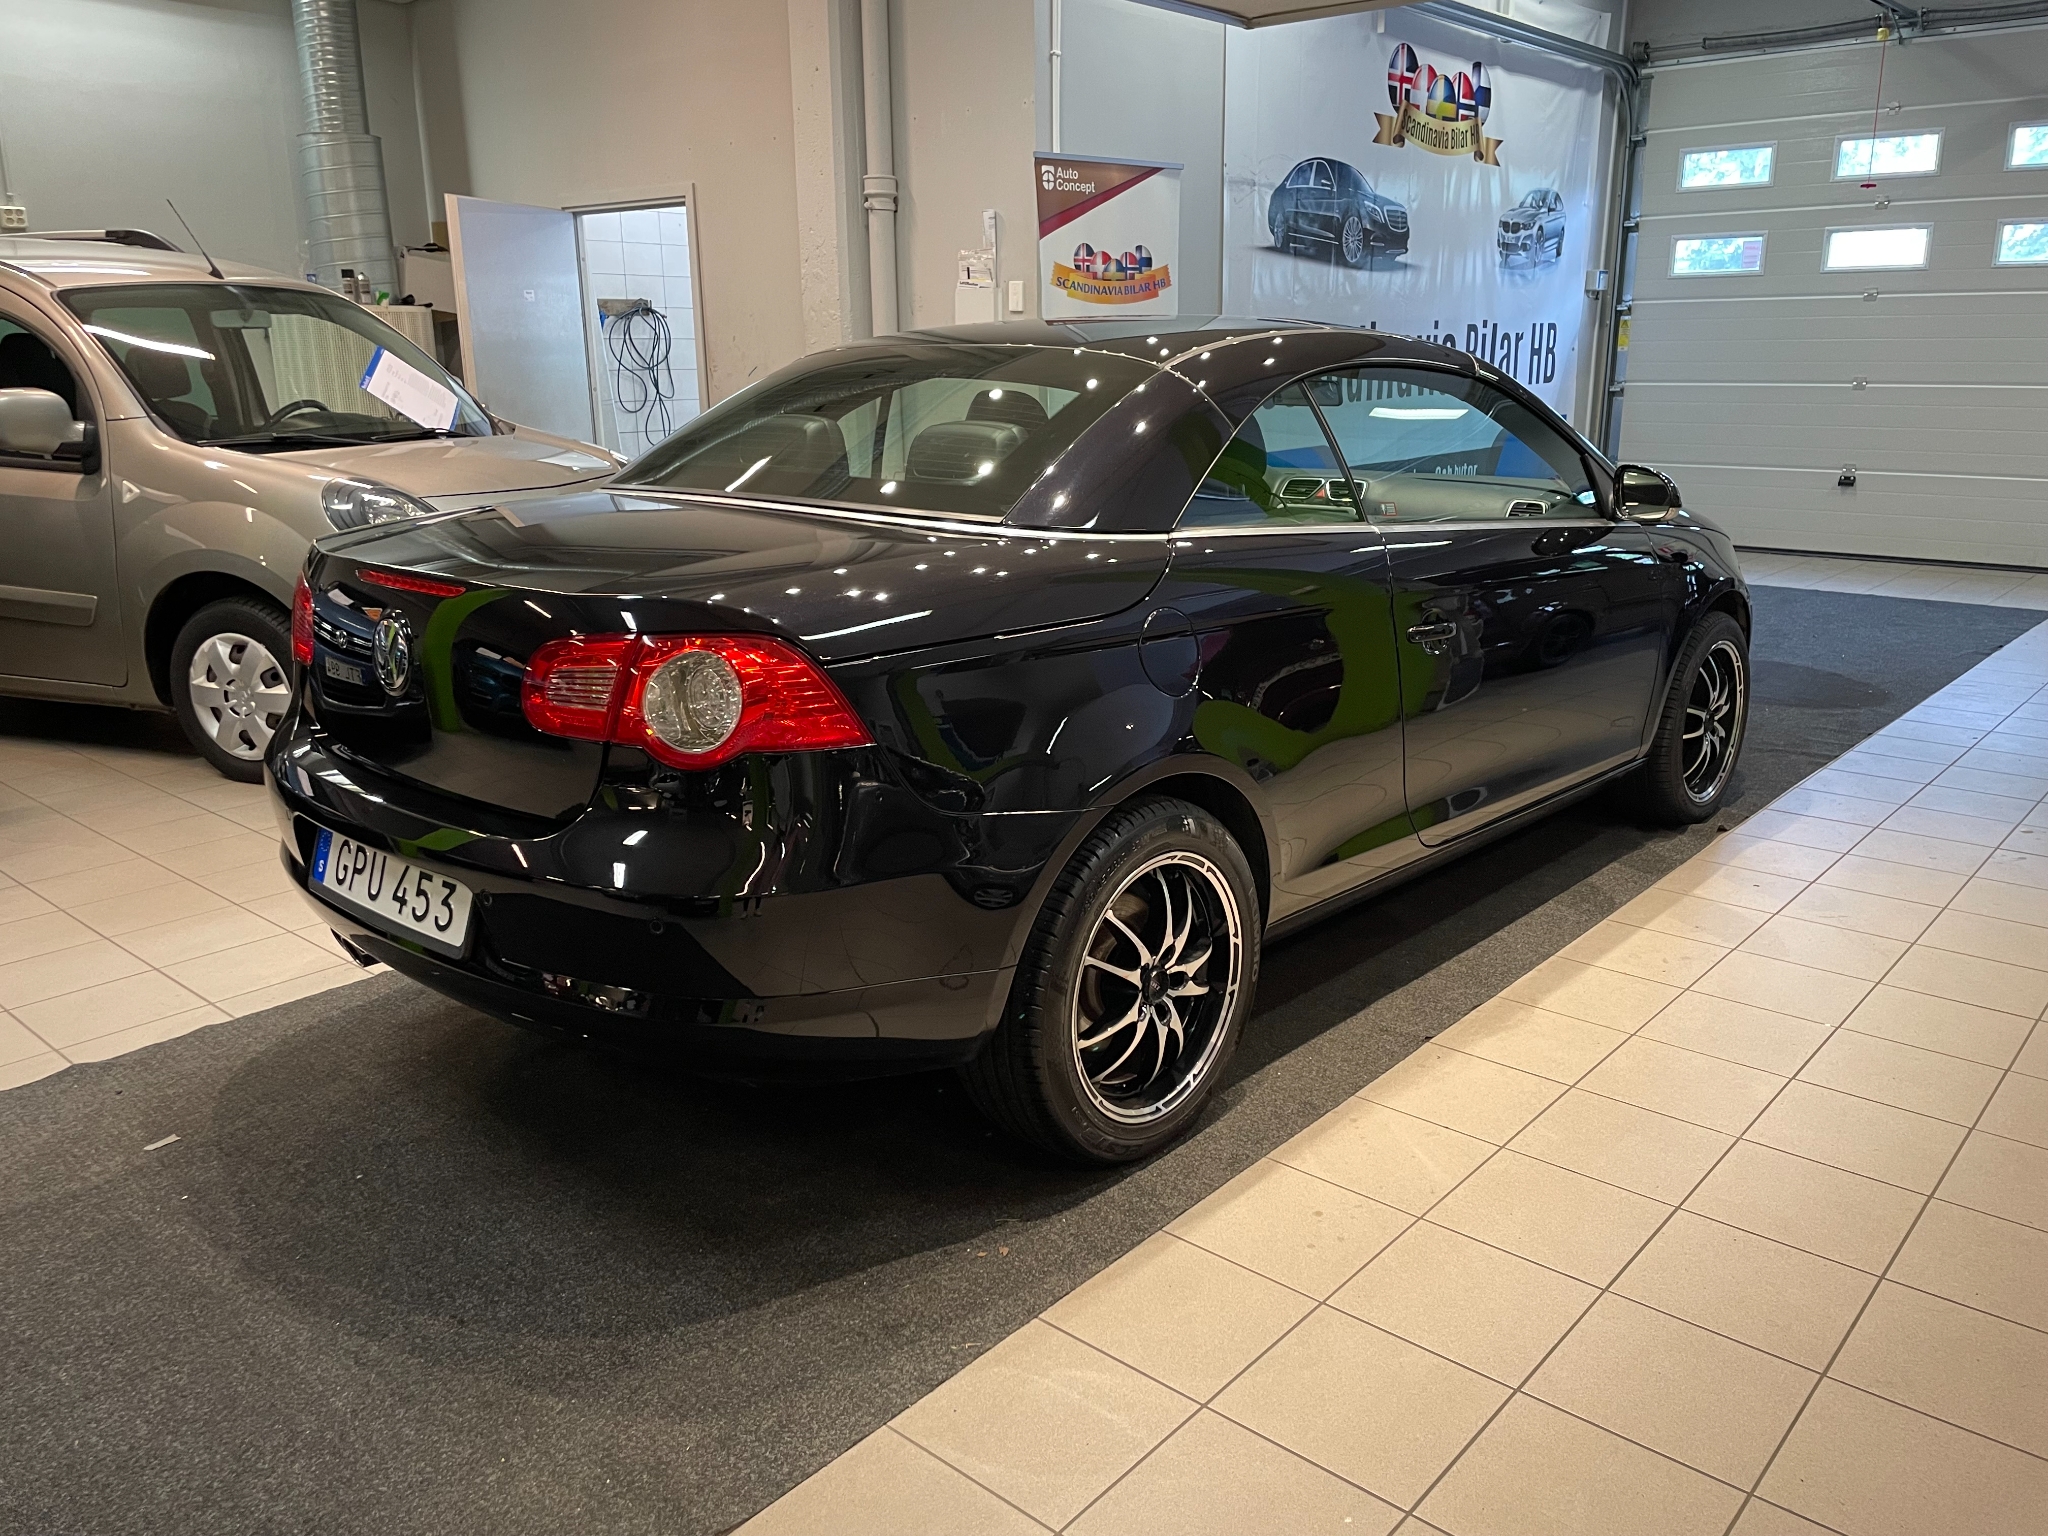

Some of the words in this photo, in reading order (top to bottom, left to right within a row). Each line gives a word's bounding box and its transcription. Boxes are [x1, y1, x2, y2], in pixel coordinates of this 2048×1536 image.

[1401, 108, 1449, 149] Scandinavia
[1451, 127, 1468, 150] Bilar
[1056, 166, 1079, 179] Auto
[1056, 179, 1095, 195] Concept
[1056, 276, 1123, 296] SCANDINAVIA
[1124, 282, 1152, 296] BILAR
[1153, 278, 1166, 289] HB
[1465, 319, 1525, 381] Bilar
[1527, 322, 1558, 385] HB
[318, 859, 325, 873] S
[335, 838, 387, 902] GPU
[392, 865, 457, 932] 453
